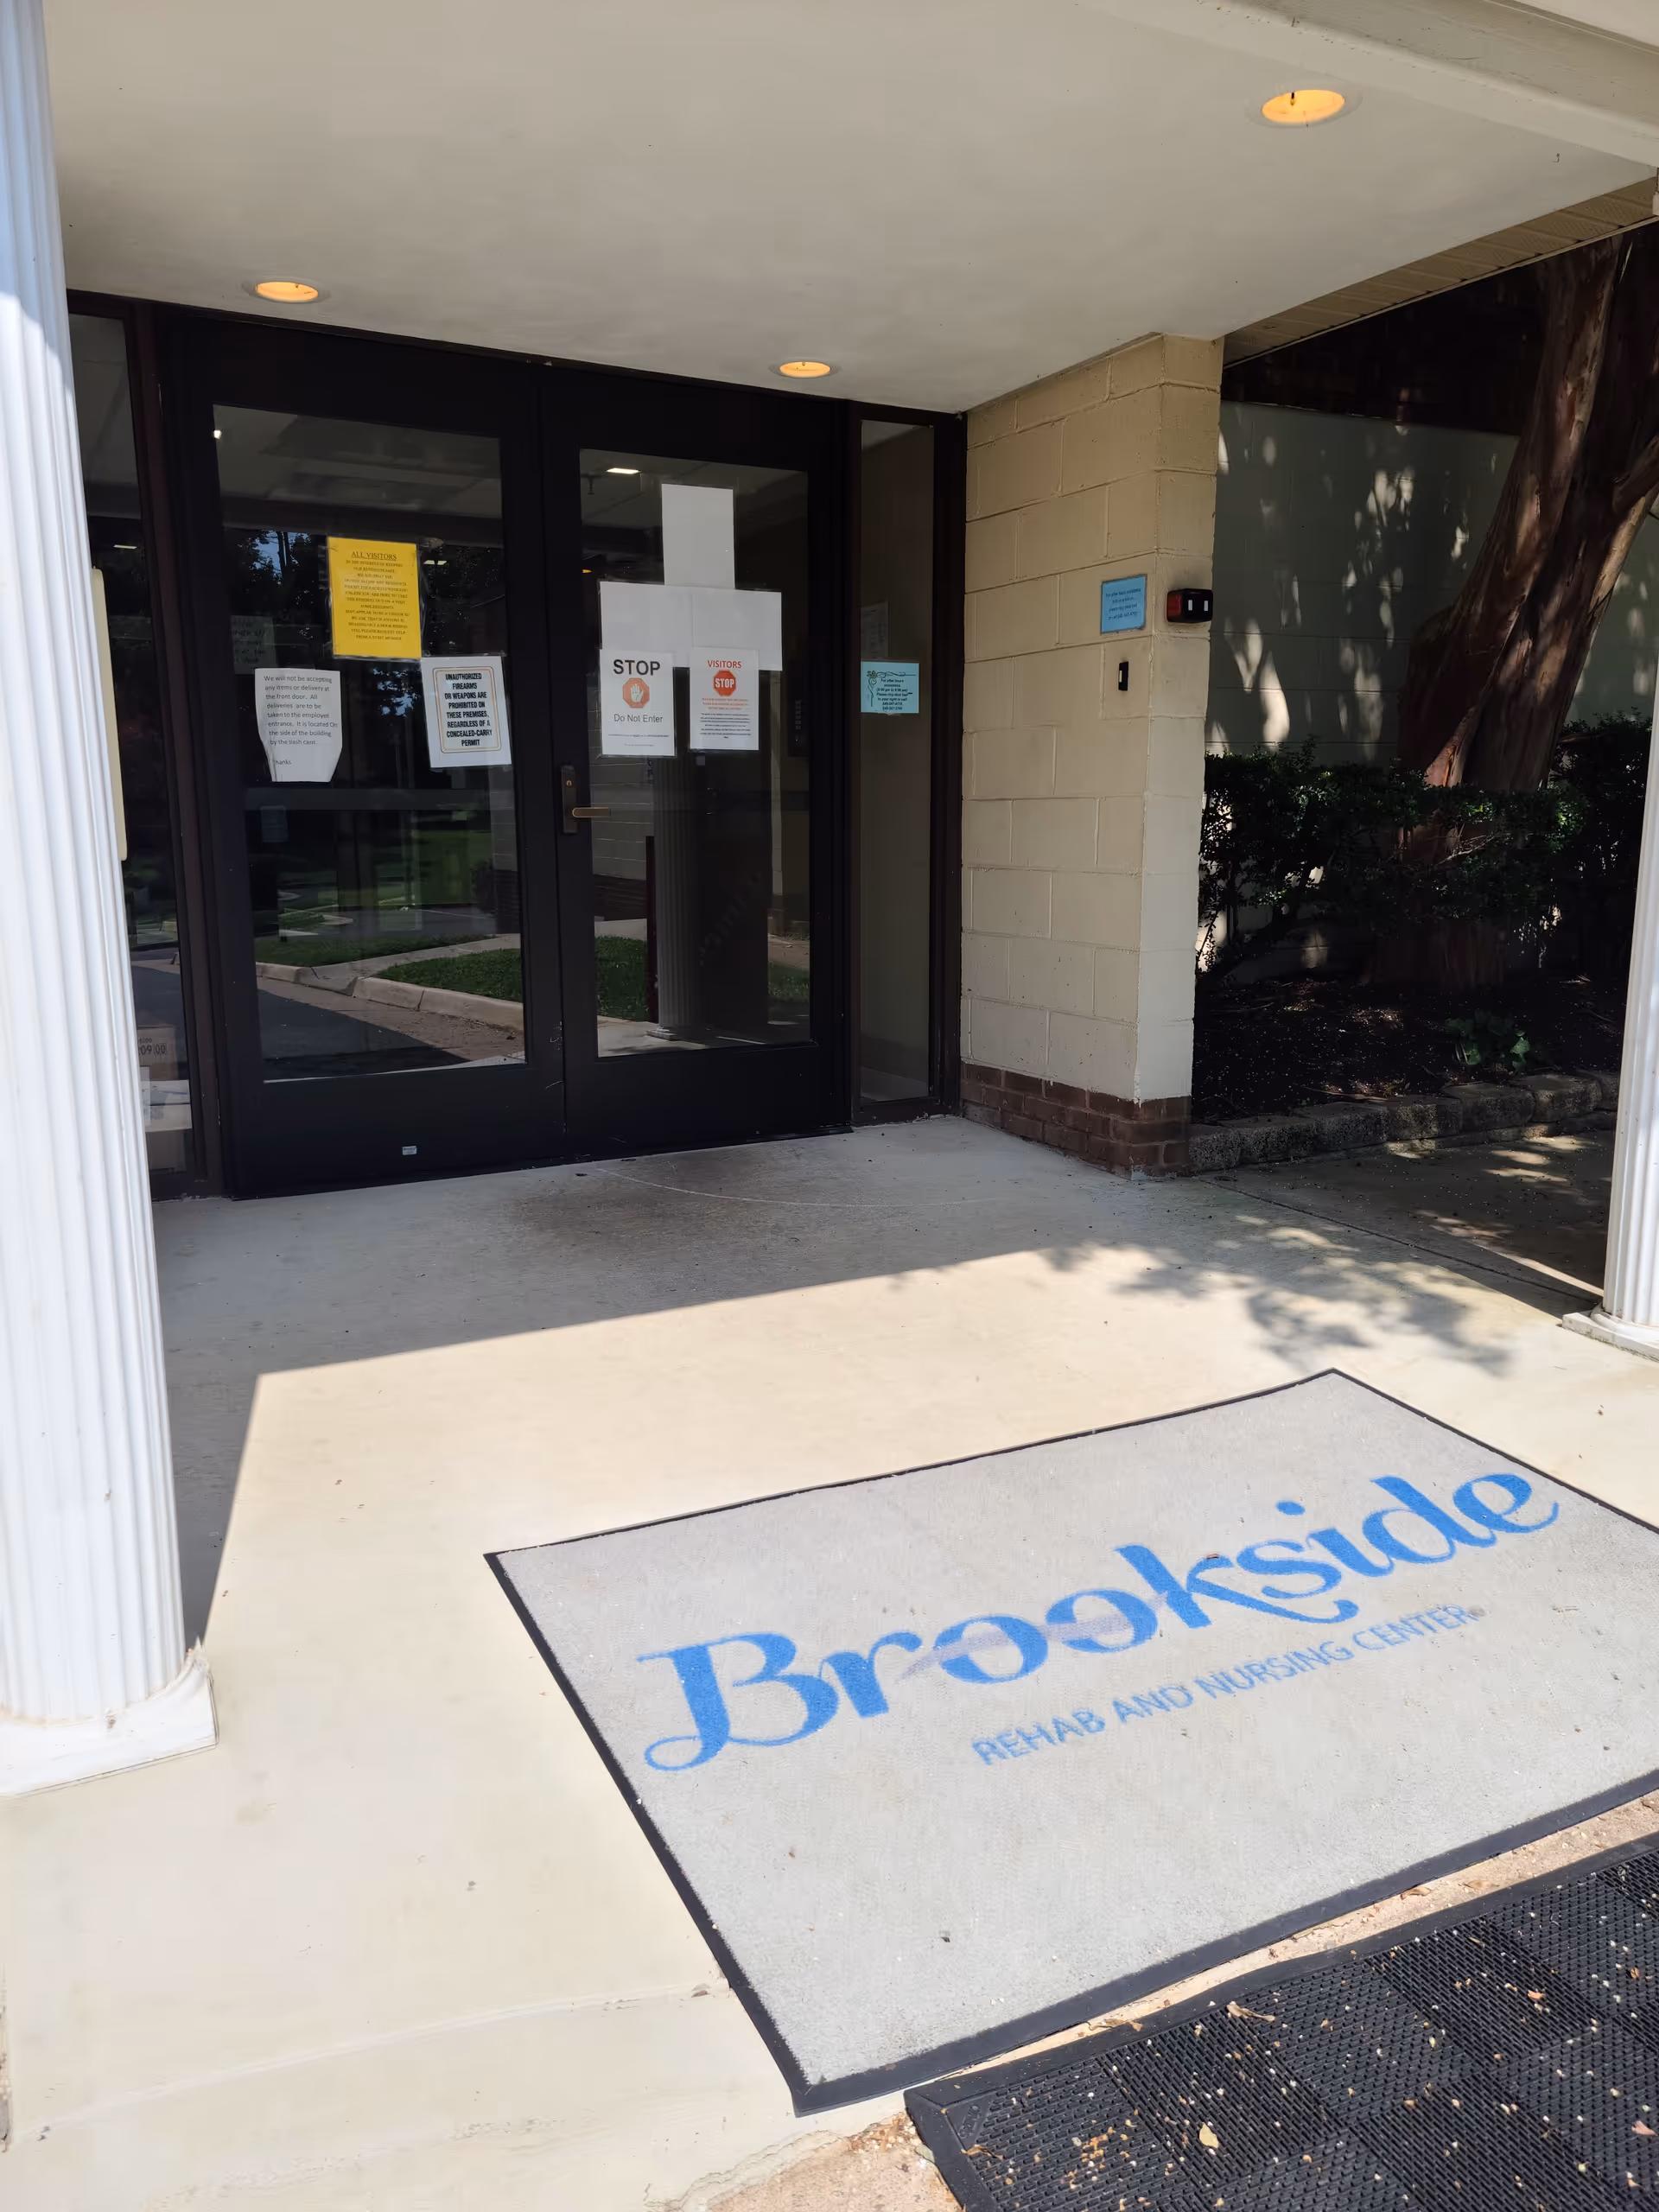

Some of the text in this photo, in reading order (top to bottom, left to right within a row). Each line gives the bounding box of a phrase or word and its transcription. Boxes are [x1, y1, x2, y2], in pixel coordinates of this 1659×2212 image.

[613, 659, 660, 675] STOP
[707, 660, 742, 668] VISITORS
[715, 678, 735, 688] STOP
[614, 714, 625, 722] Do
[643, 714, 663, 723] Enter
[447, 729, 493, 737] CONCEALED-CARRY
[637, 1474, 1559, 1771] Brookside
[971, 1603, 1478, 1765] REHAB AND NURSING CENTER
